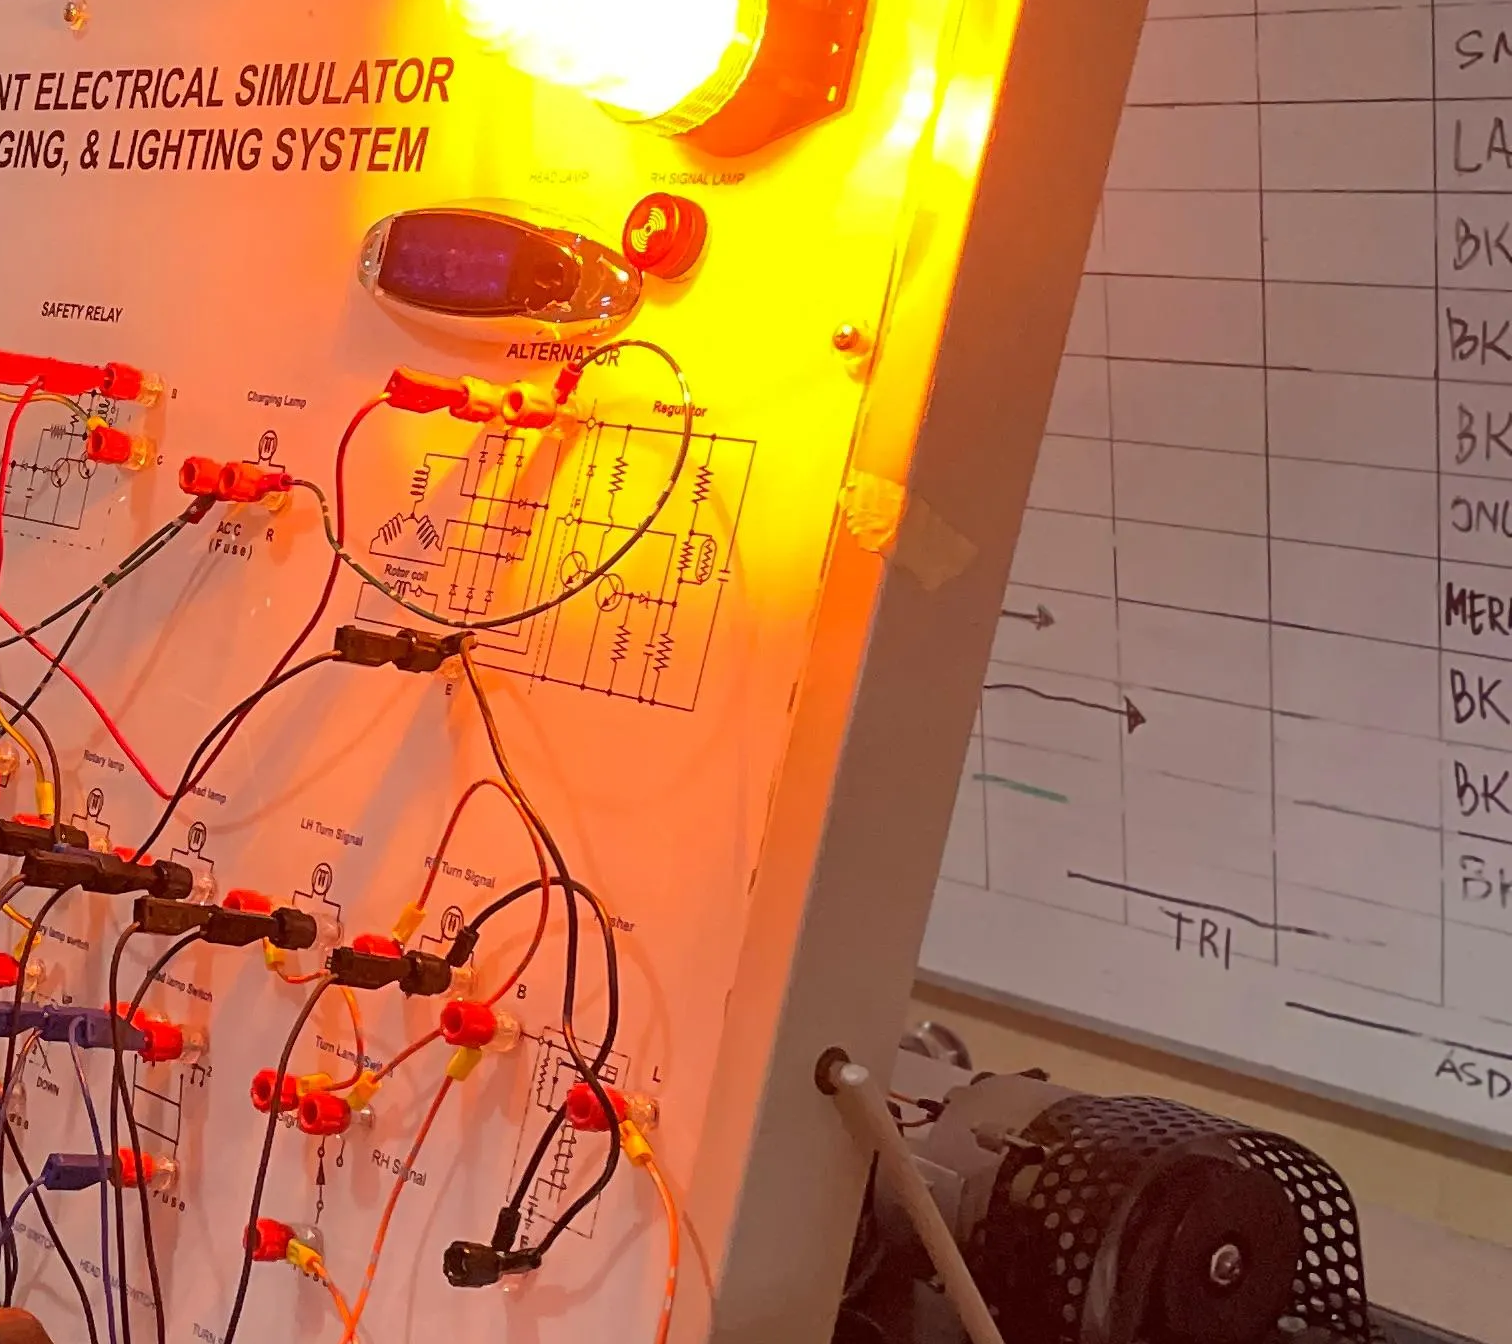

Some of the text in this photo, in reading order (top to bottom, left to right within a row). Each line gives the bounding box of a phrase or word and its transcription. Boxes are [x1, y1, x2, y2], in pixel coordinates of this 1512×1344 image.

[34, 66, 224, 111] ELECTRICAL
[235, 57, 454, 107] SIMULATOR
[80, 129, 100, 170] &
[108, 128, 263, 171] LIGHTING
[272, 127, 429, 172] SYSTEM
[651, 172, 745, 186] RH SIGNAL LAMP
[41, 301, 123, 323] SAFETY RELAY
[506, 341, 621, 367] ALTERNATOR
[247, 390, 307, 409] Charging Lamp
[653, 400, 708, 419] Regultor
[266, 528, 275, 542] R
[384, 563, 429, 582] Rotor coil
[1445, 581, 1512, 637] MER
[445, 683, 452, 696] E
[1450, 668, 1512, 724] BK
[1454, 760, 1512, 816] BK
[300, 817, 364, 847] LH Turn Signal
[442, 859, 463, 879] Turn
[464, 866, 496, 890] Signal
[516, 983, 527, 1000] B
[315, 1034, 335, 1054] Turn
[652, 1066, 662, 1084] L
[36, 1076, 59, 1096] DOWN
[371, 1149, 427, 1187] RH Sgnal
